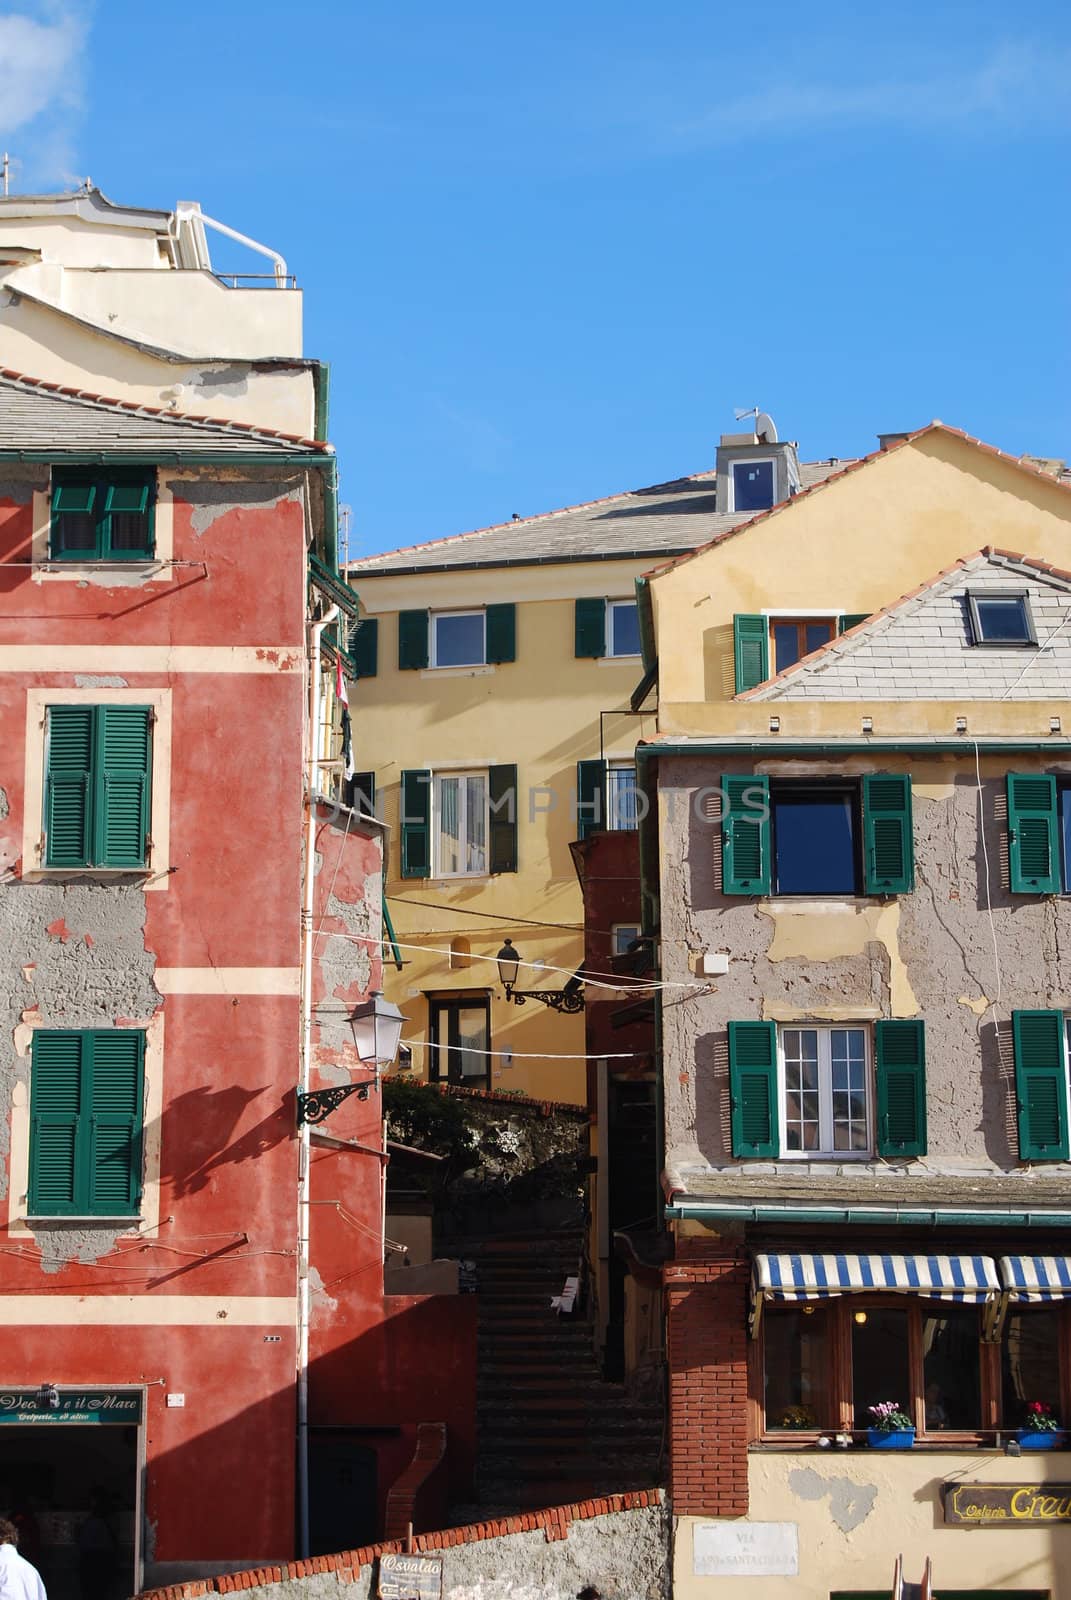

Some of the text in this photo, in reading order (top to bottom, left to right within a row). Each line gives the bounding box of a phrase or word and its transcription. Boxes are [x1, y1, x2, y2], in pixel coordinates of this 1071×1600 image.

[63, 1400, 71, 1408] e
[75, 1396, 85, 1408] il
[87, 1395, 136, 1409] Mare
[736, 1533, 756, 1544] VIA
[381, 1555, 441, 1574] Osvaldo
